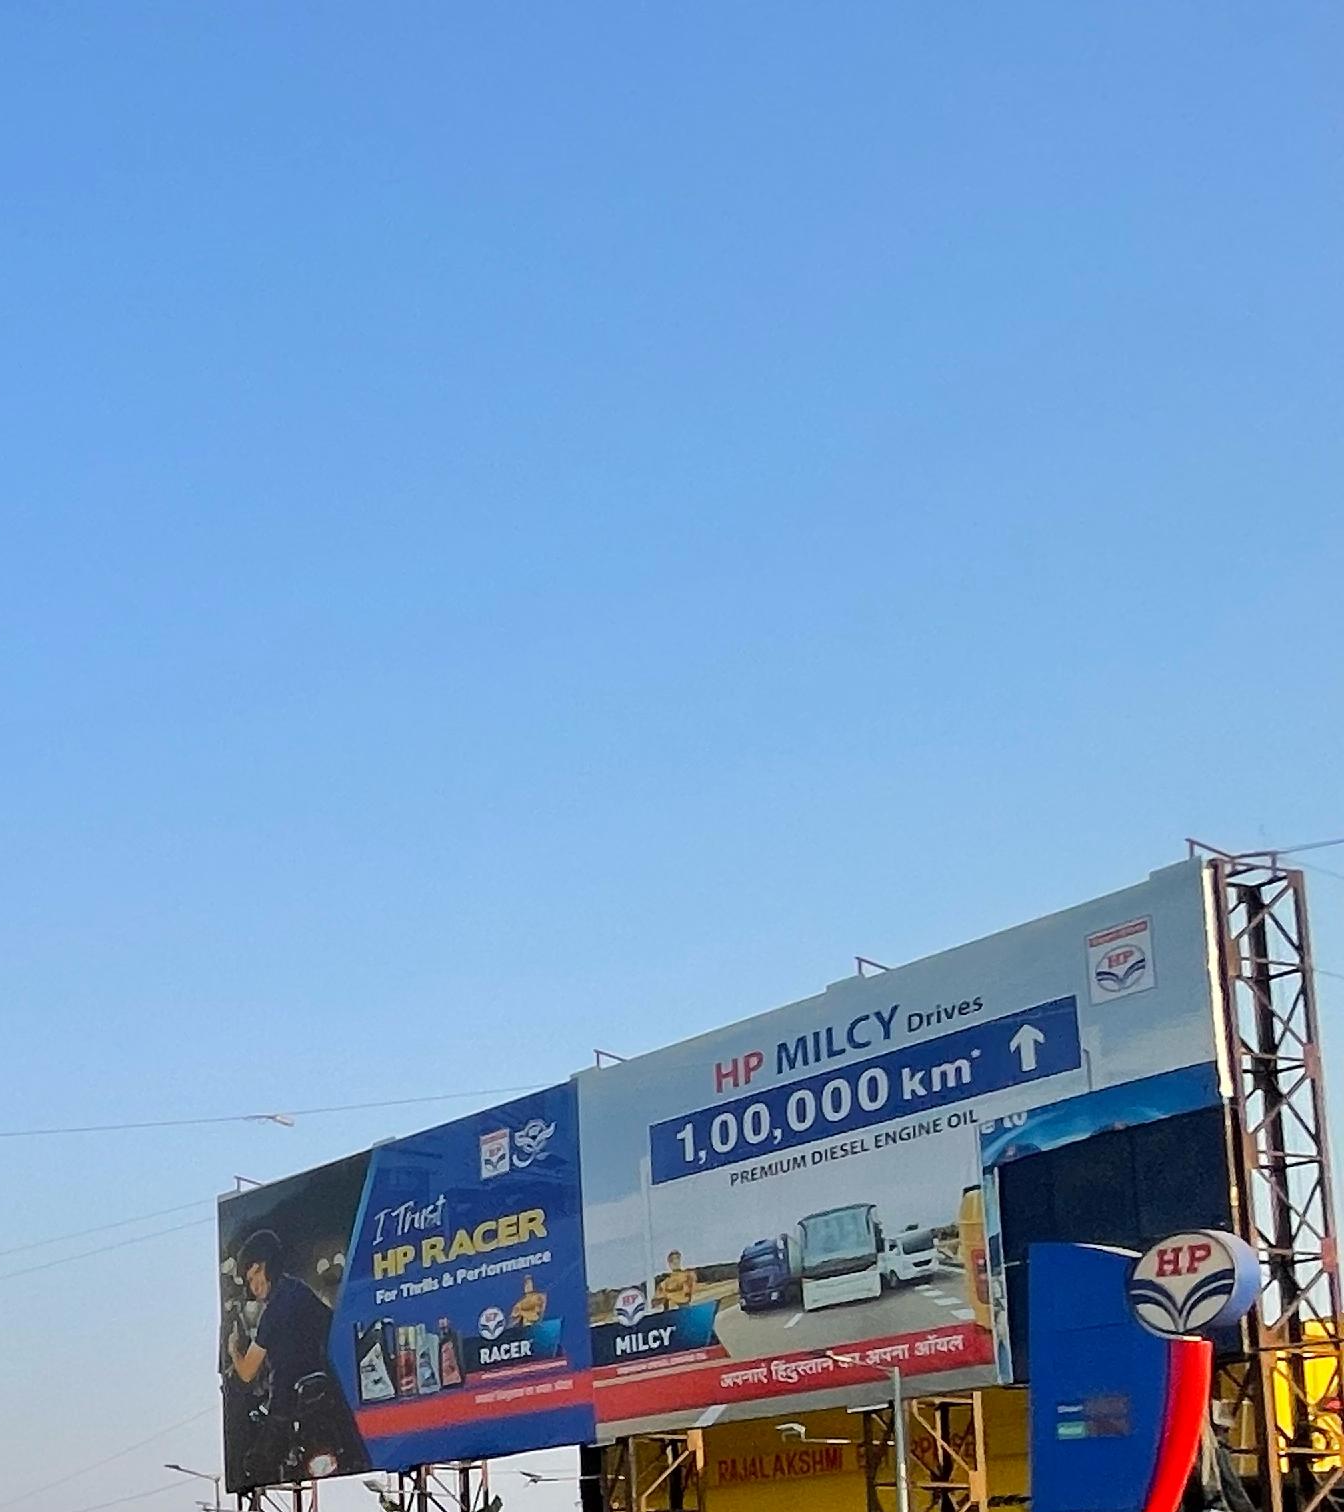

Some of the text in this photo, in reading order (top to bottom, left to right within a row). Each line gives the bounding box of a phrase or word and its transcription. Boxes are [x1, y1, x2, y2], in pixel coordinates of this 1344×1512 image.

[715, 997, 985, 1094] HP MILCY Drives
[676, 1067, 890, 1165] 1,00,000
[729, 1155, 808, 1187] PREMIUM
[811, 1138, 868, 1166] DIESEL
[874, 1117, 944, 1150] ENGINE
[946, 1109, 979, 1129] OIL
[372, 1194, 447, 1246] I Trust
[374, 1208, 548, 1281] HP RACER
[375, 1288, 399, 1305] For
[442, 1271, 455, 1288] &
[456, 1250, 552, 1285] Performance
[1156, 1244, 1212, 1277] HP
[480, 1340, 532, 1365] RACER
[615, 1327, 673, 1356] MILCY
